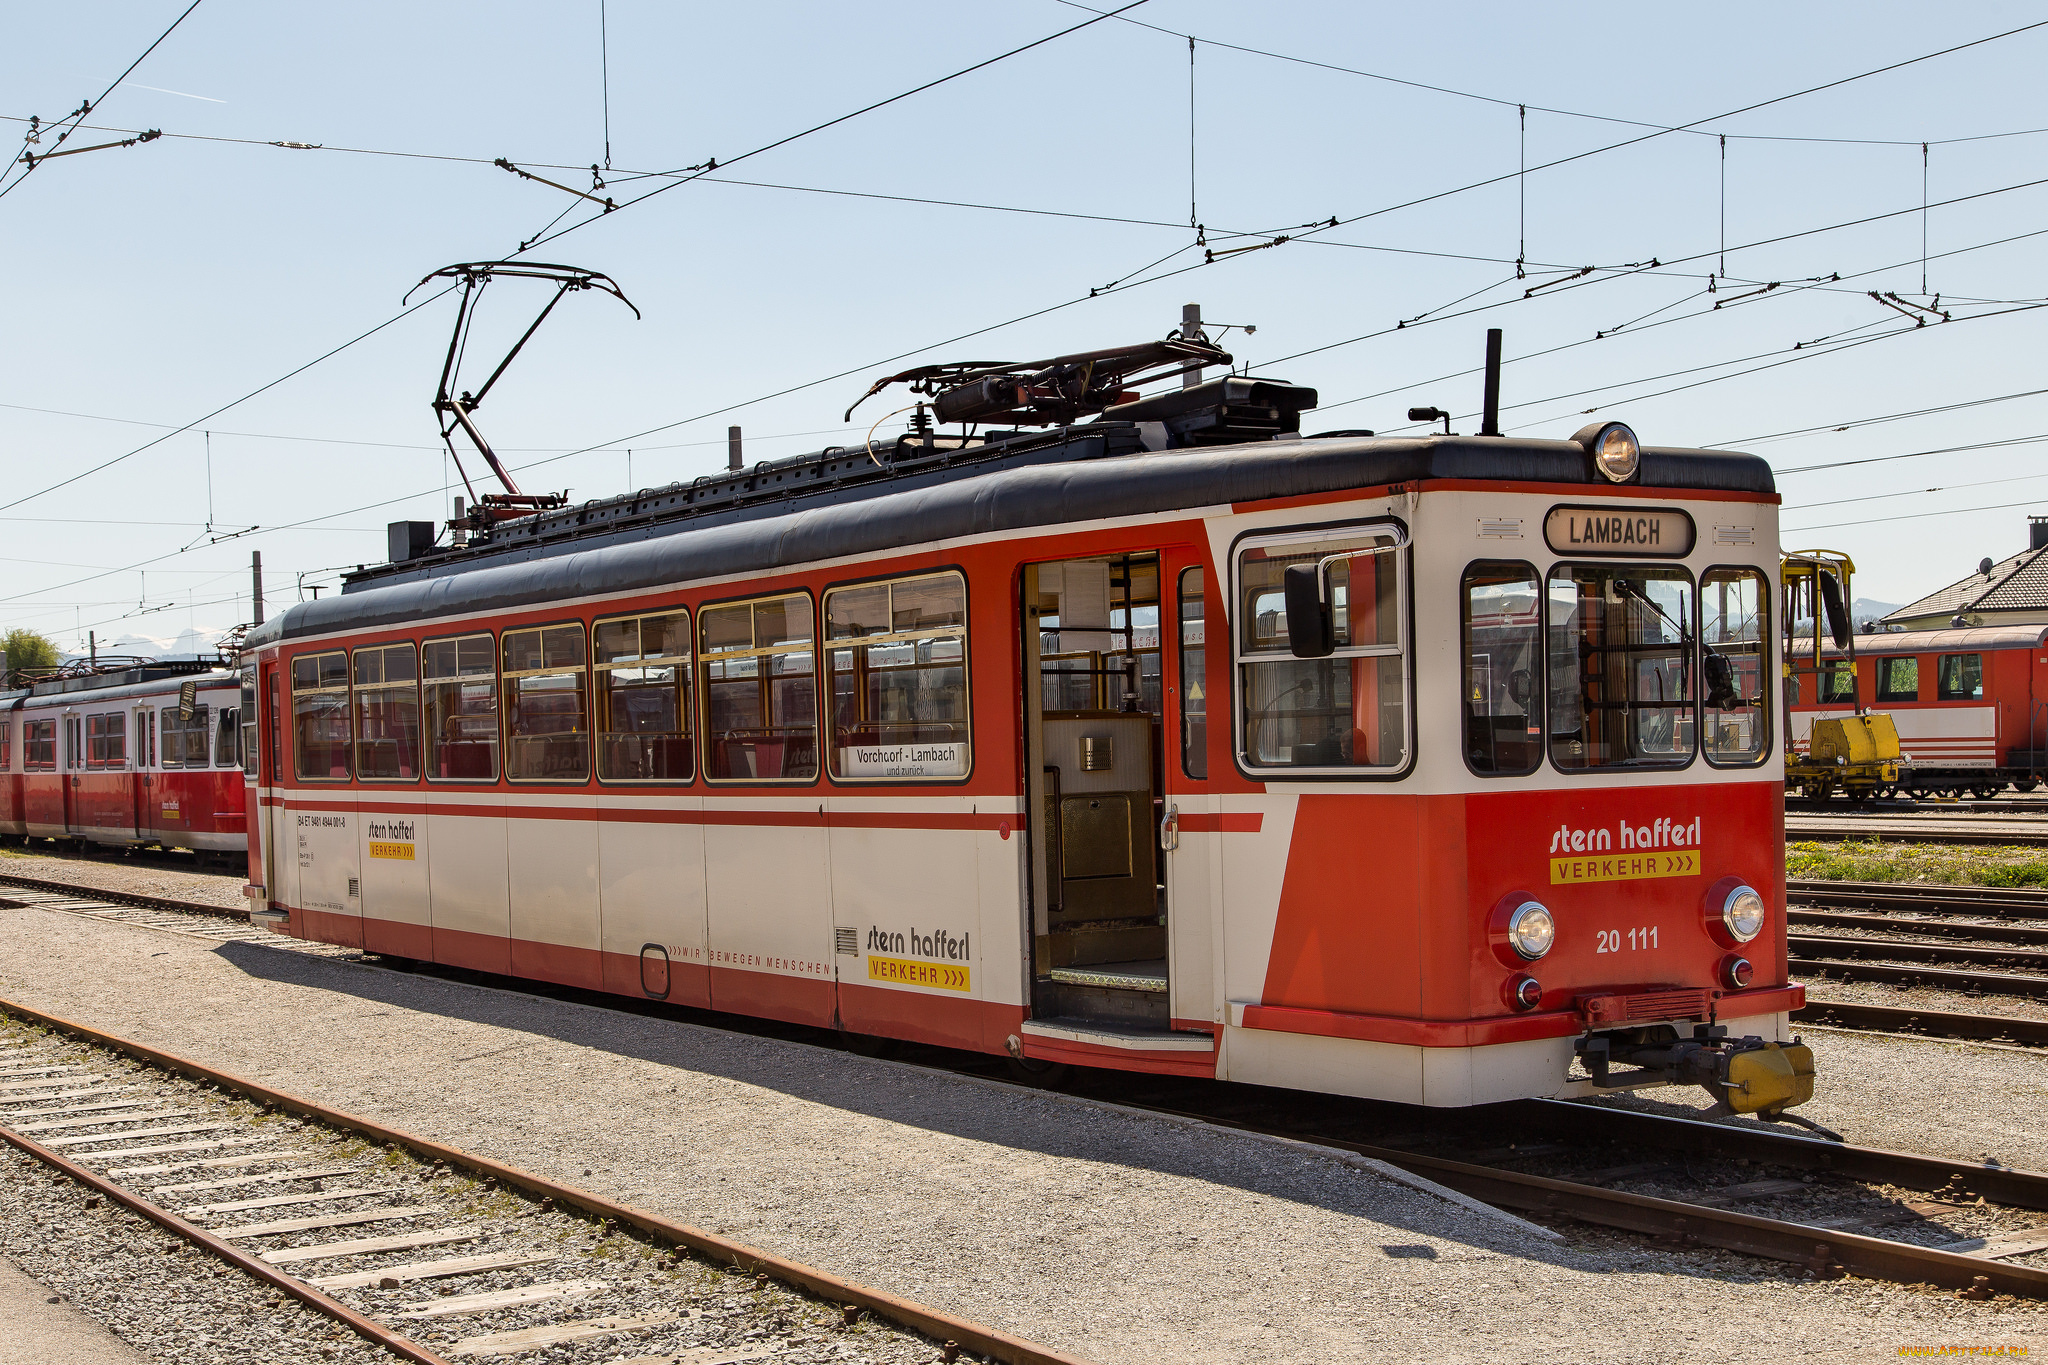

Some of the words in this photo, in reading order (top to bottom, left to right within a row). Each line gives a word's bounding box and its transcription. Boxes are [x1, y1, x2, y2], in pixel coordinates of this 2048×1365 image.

[1570, 516, 1660, 545] LAMBACH
[911, 746, 955, 762] Lambach
[886, 767, 900, 776] und
[901, 765, 925, 776] zurück
[304, 815, 311, 827] ET
[311, 816, 322, 827] 9481
[368, 820, 387, 839] stern
[388, 820, 415, 840] hafferl
[1550, 824, 1611, 854] stern
[1620, 816, 1701, 849] hafferl
[371, 845, 401, 857] VERKEHR
[1558, 858, 1657, 879] VERKEHR
[867, 925, 905, 954] stern
[911, 927, 970, 960] hafferl
[1596, 929, 1621, 953] 20
[1628, 926, 1658, 950] 111
[682, 948, 700, 958] WIR
[709, 950, 761, 966] BEWEGEN
[766, 957, 830, 975] MENSCHEN
[872, 960, 938, 983] VERKEHR
